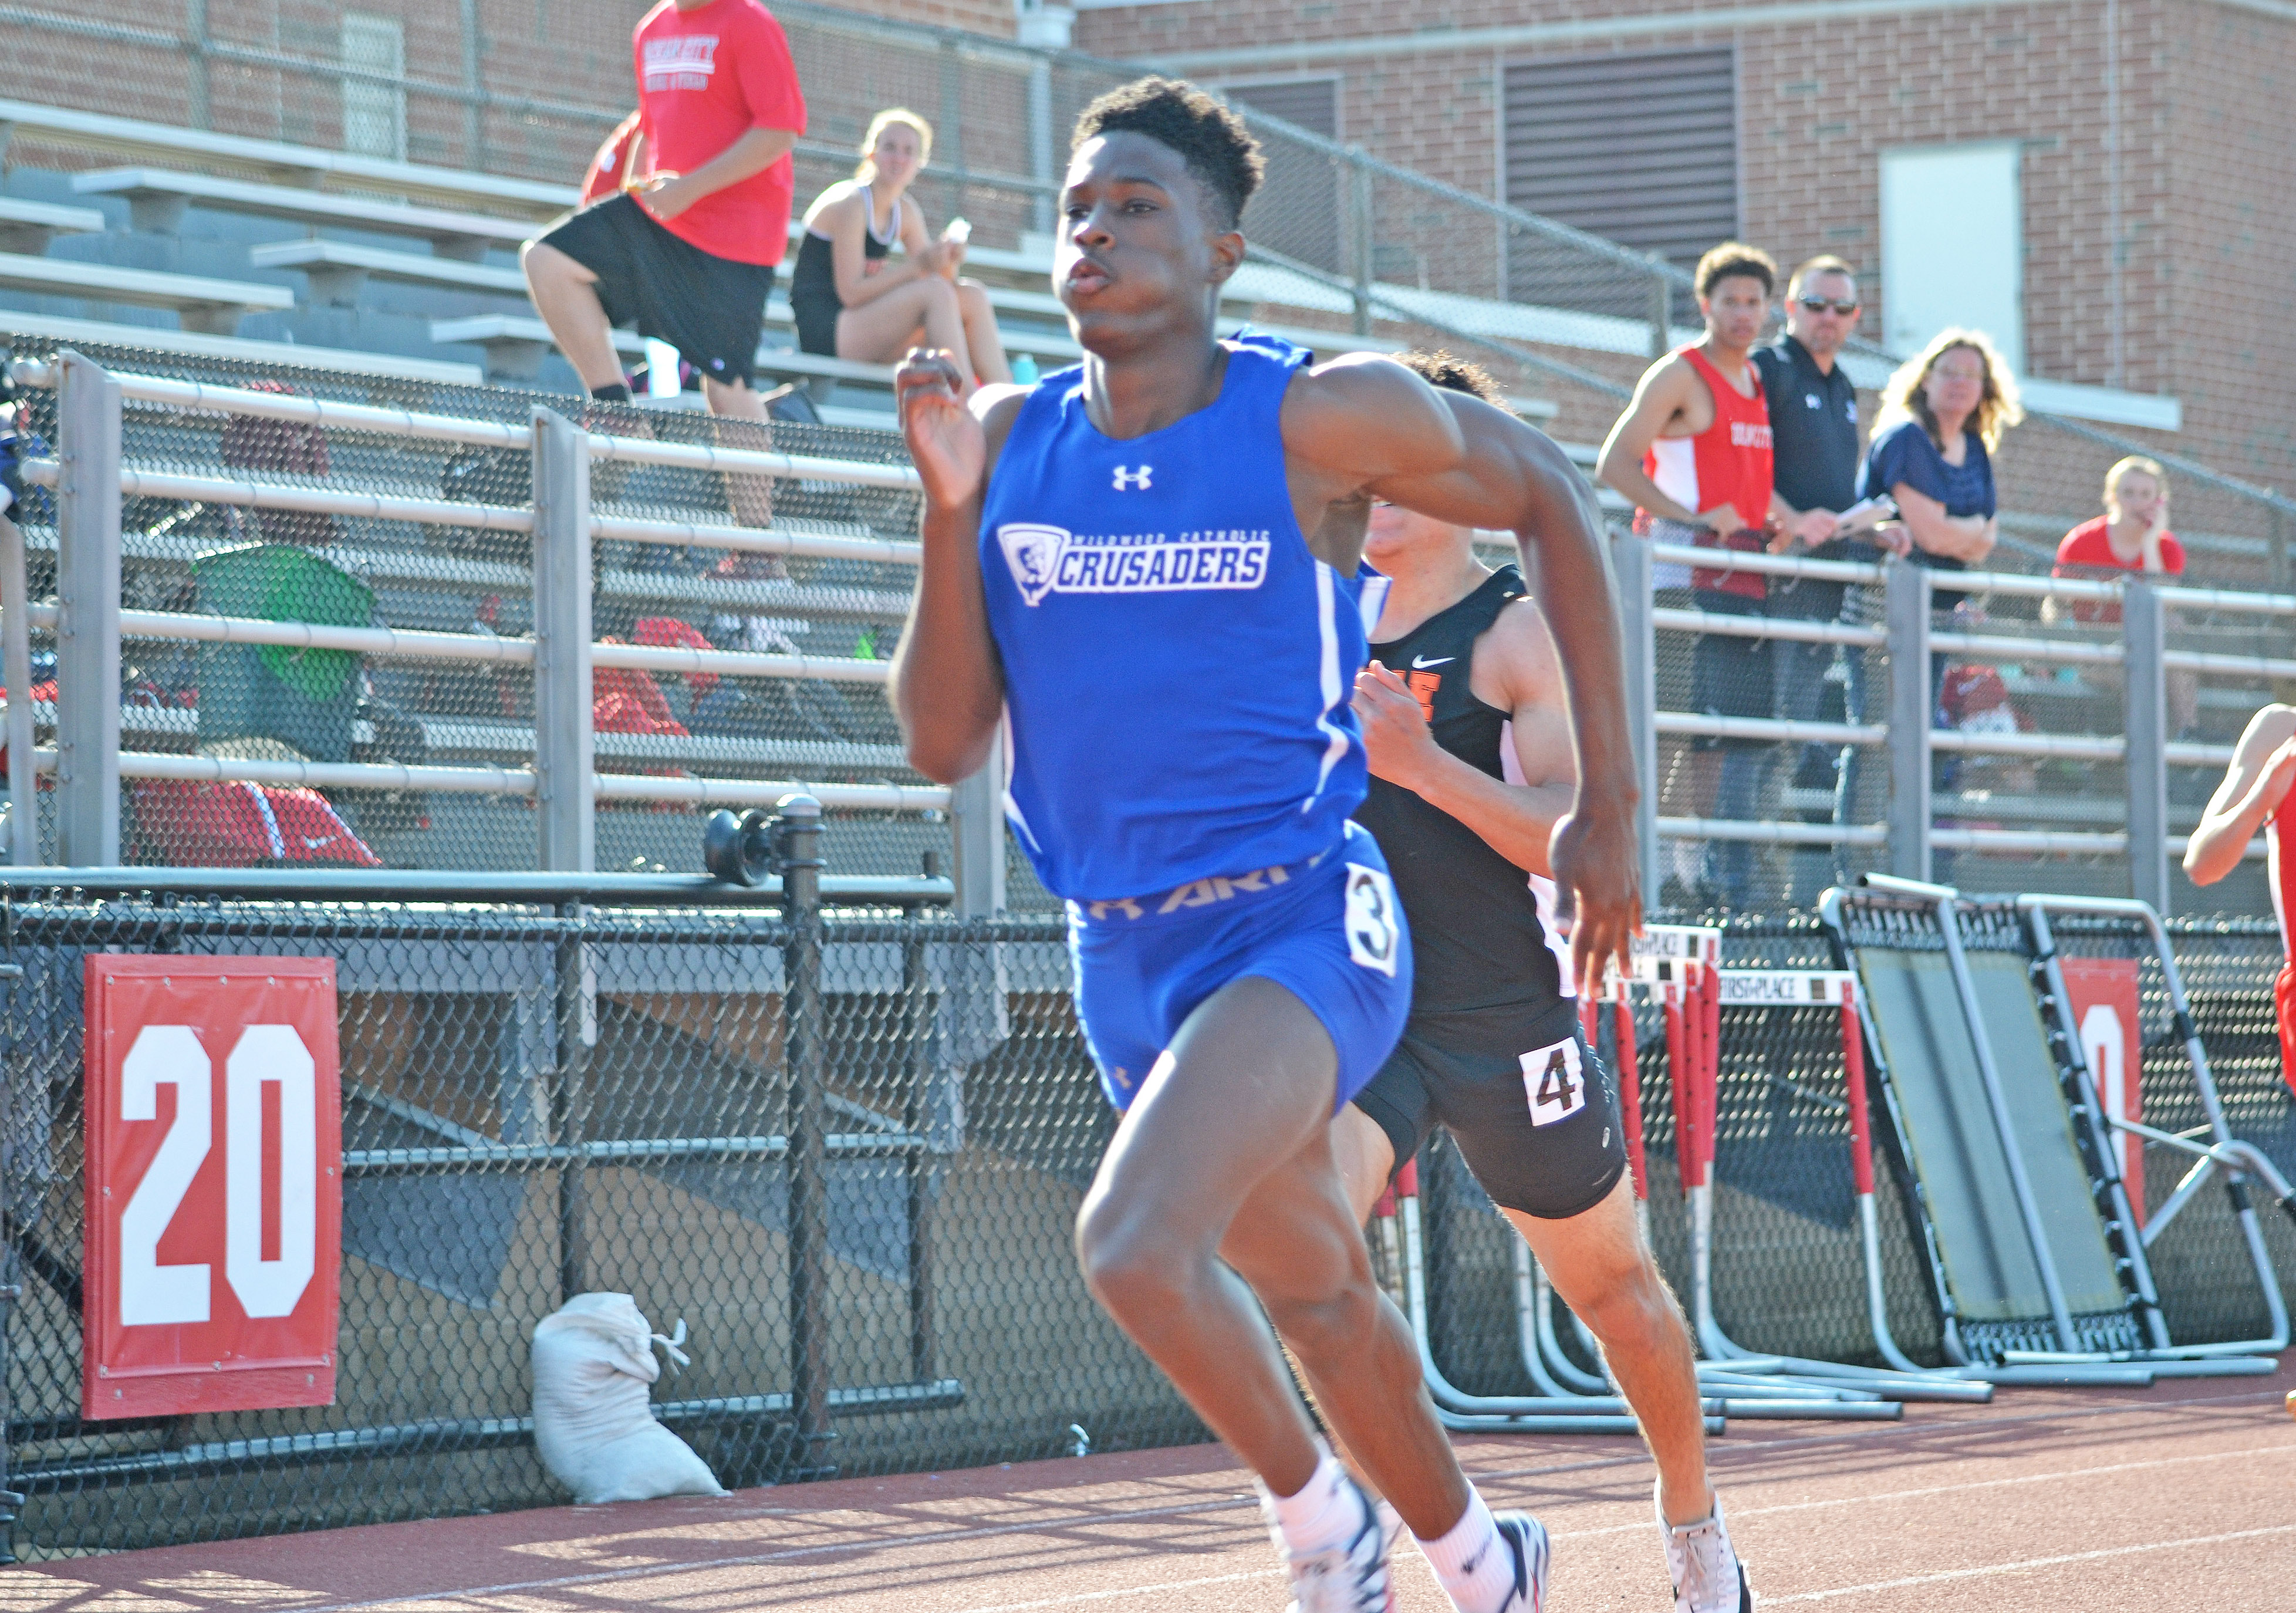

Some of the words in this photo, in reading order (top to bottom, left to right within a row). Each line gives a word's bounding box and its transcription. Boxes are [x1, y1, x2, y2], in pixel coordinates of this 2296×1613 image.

[1058, 546, 1265, 586] CRUSADERS
[1180, 530, 1270, 544] CATHOLIC
[1353, 873, 1392, 961] 3
[1537, 1047, 1576, 1111] 4
[120, 1024, 316, 1327] 20
